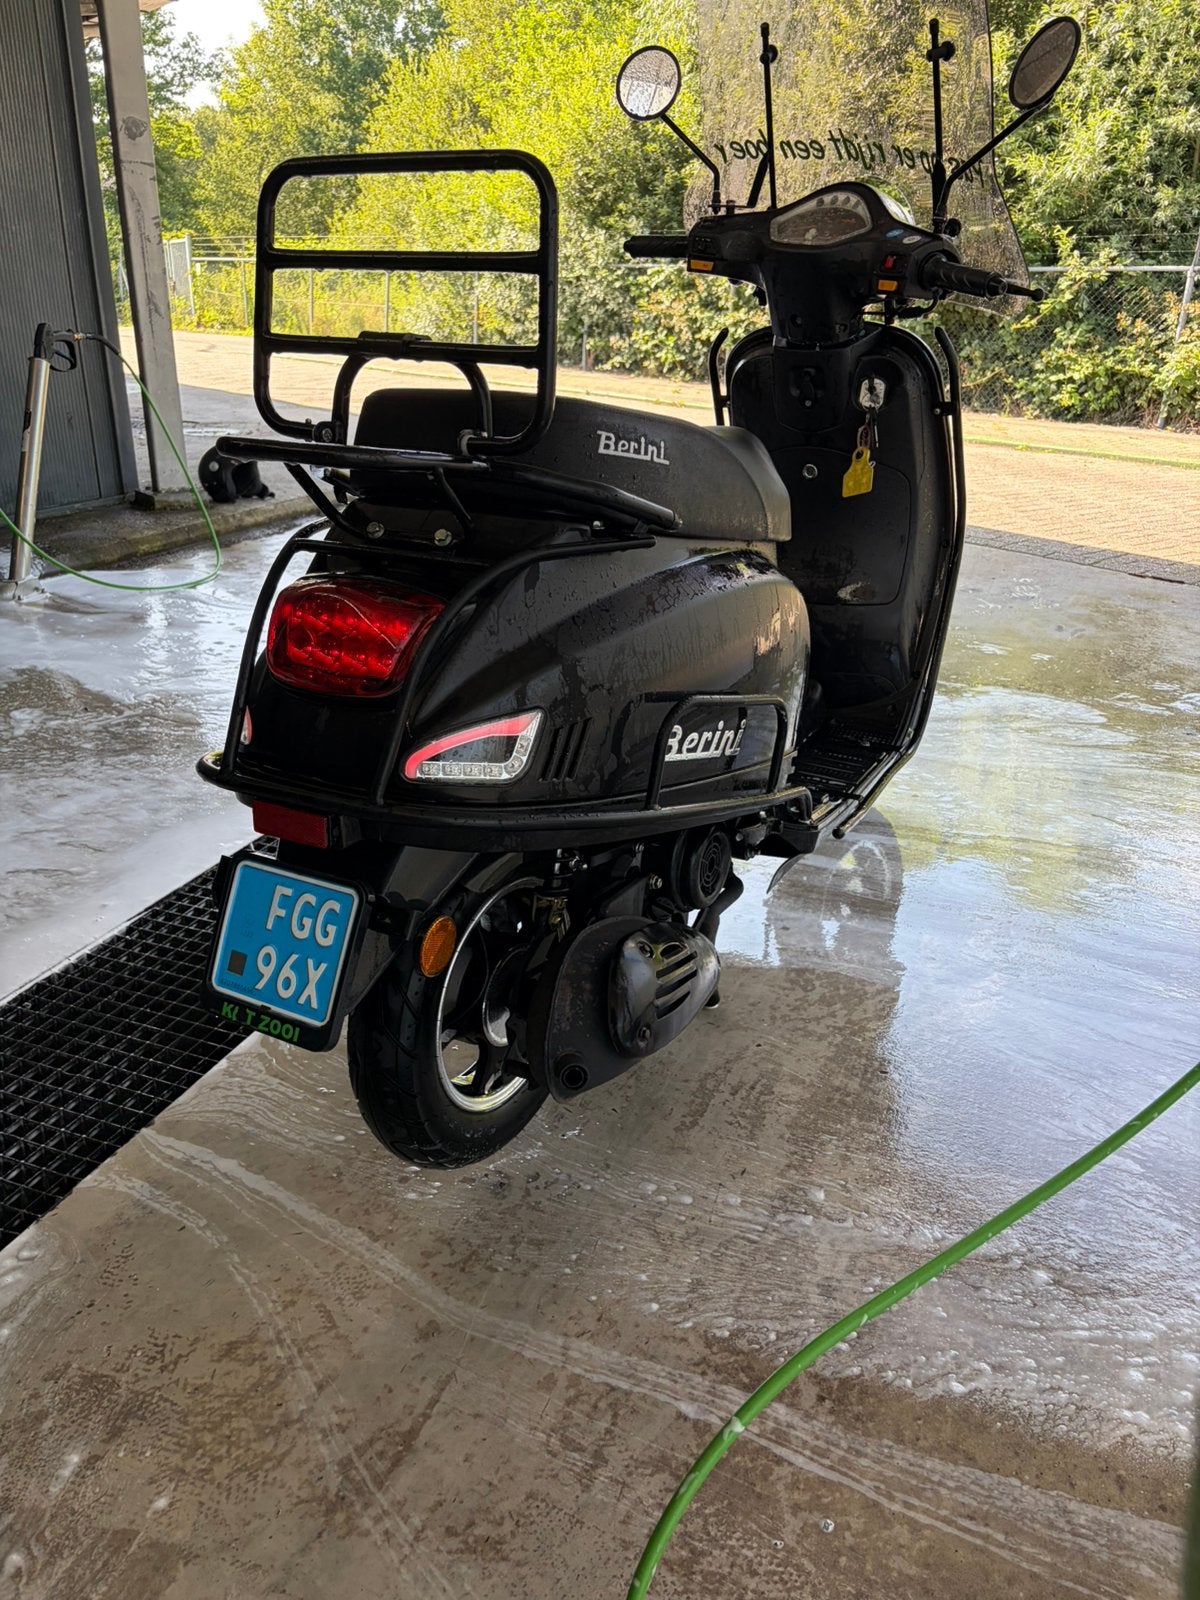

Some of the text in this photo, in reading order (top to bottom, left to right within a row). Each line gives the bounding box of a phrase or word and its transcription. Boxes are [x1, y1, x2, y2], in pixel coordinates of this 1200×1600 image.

[596, 430, 670, 465] Berini
[664, 719, 747, 762] Berini
[265, 884, 341, 947] FGG
[254, 945, 328, 1009] 96X
[257, 1014, 301, 1043] ZOOI
